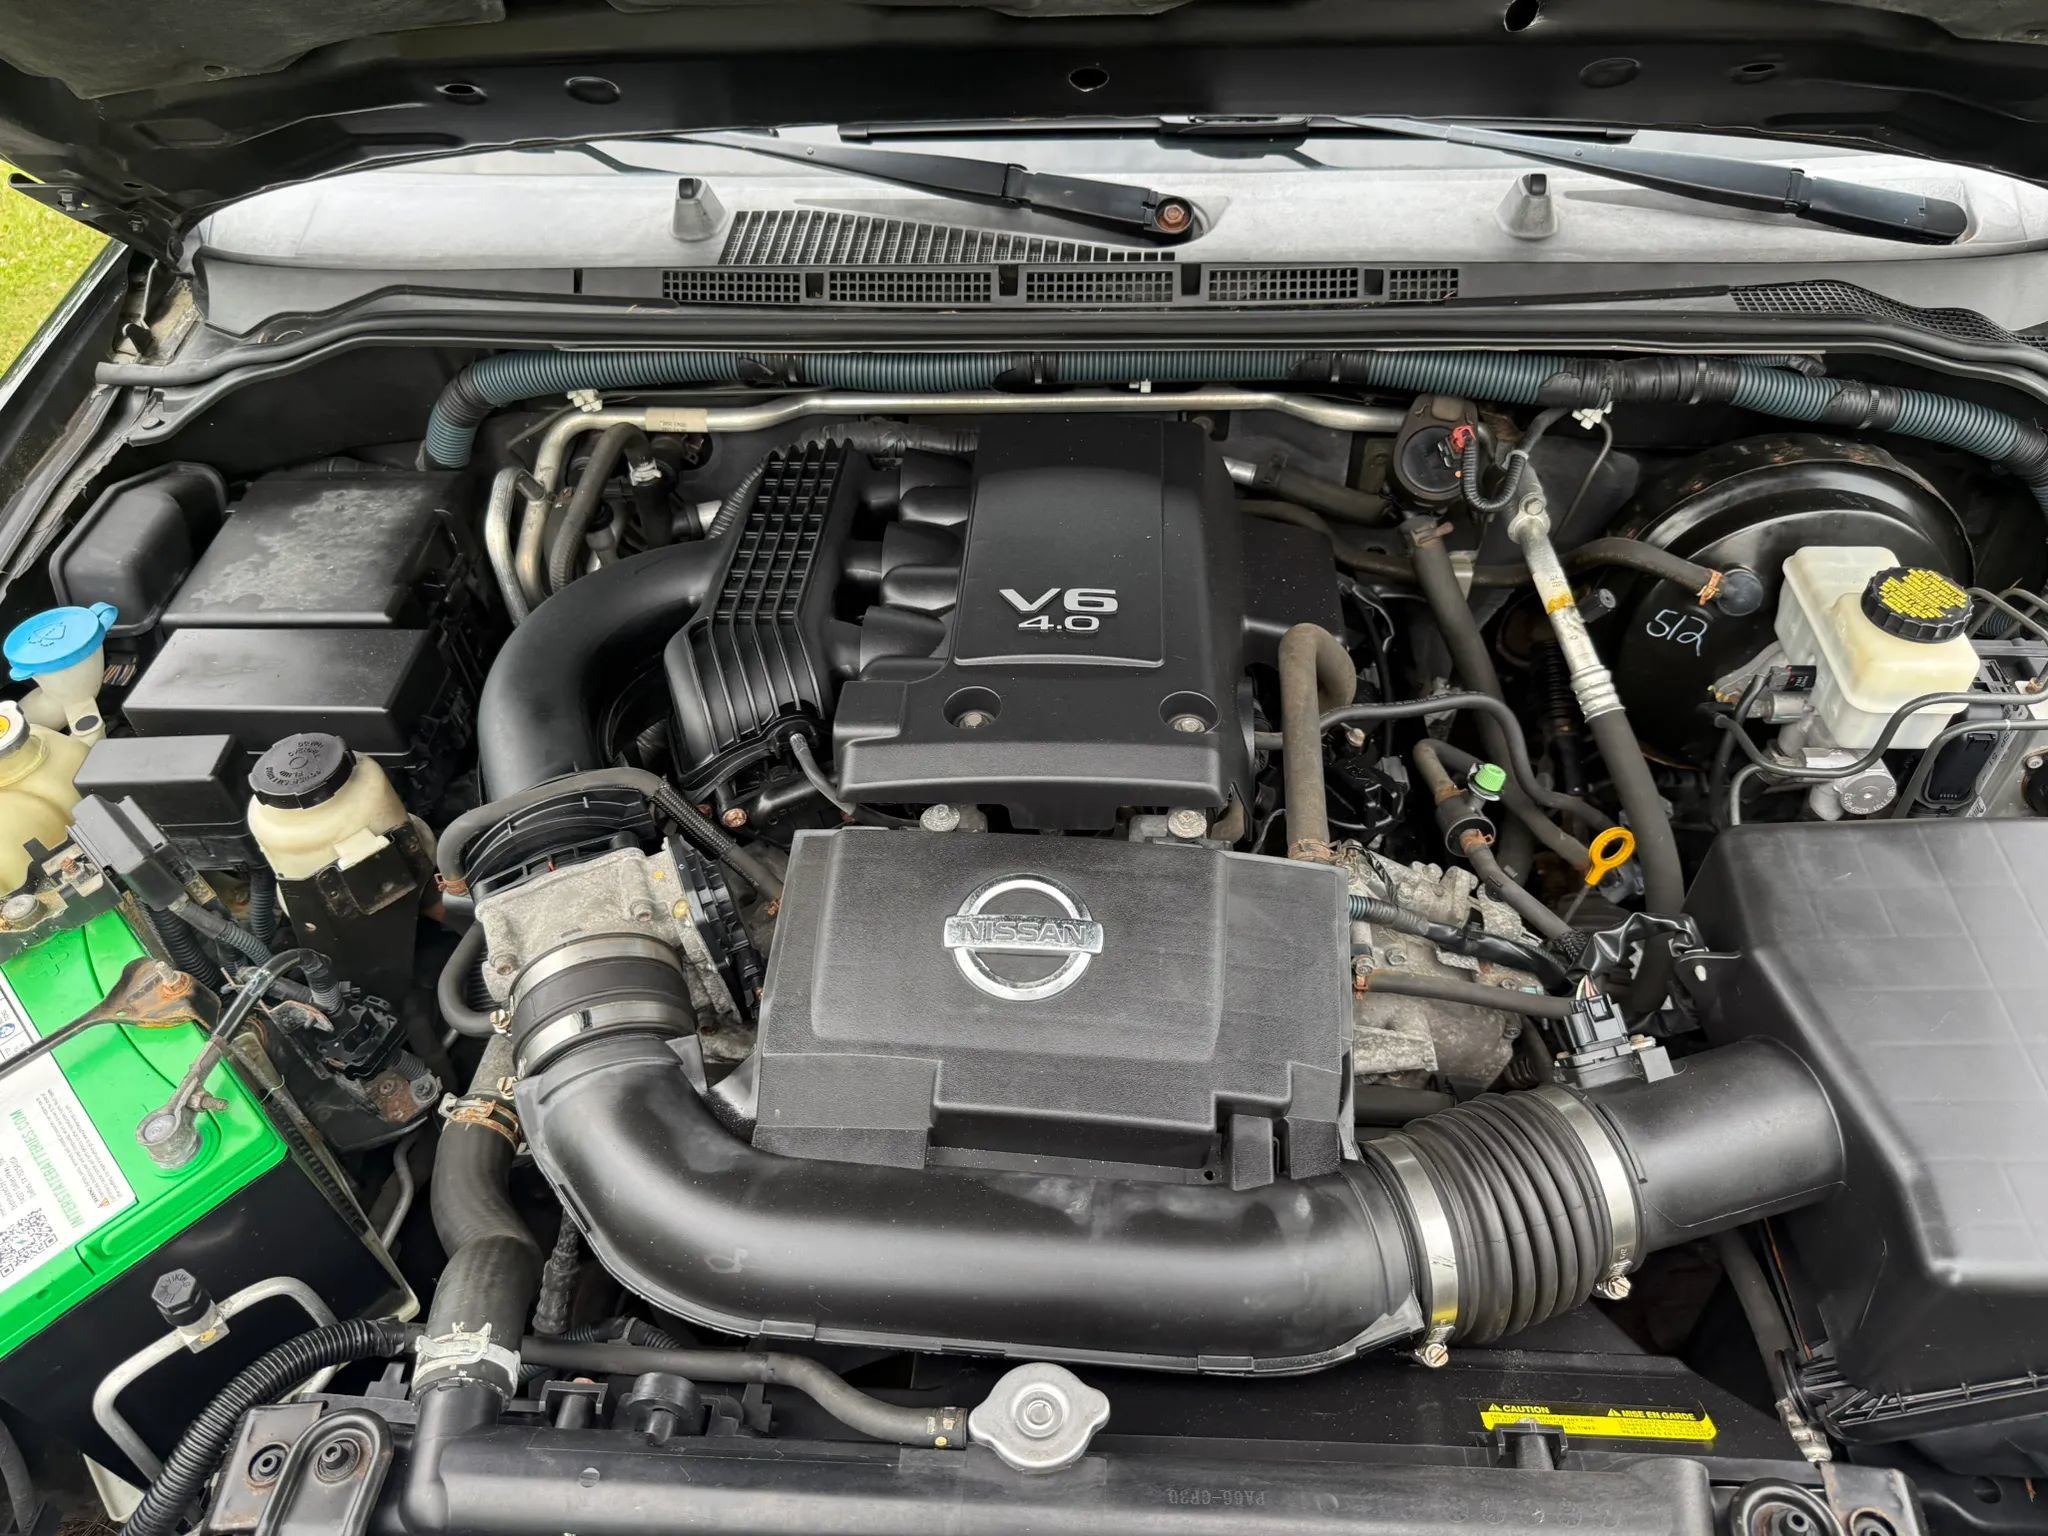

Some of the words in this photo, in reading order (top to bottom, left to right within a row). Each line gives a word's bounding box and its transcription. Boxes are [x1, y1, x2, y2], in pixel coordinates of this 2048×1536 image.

[999, 588, 1119, 614] V6
[1017, 615, 1100, 633] 4.0
[1646, 608, 1708, 657] 512
[959, 920, 1088, 945] NISSAN
[9, 1108, 86, 1229] INTERSTATEBATTERIES.COM
[1502, 1405, 1550, 1414] CAUTION
[1621, 1410, 1646, 1418] MISE
[1646, 1411, 1661, 1419] EN
[1661, 1412, 1696, 1421] GARDE
